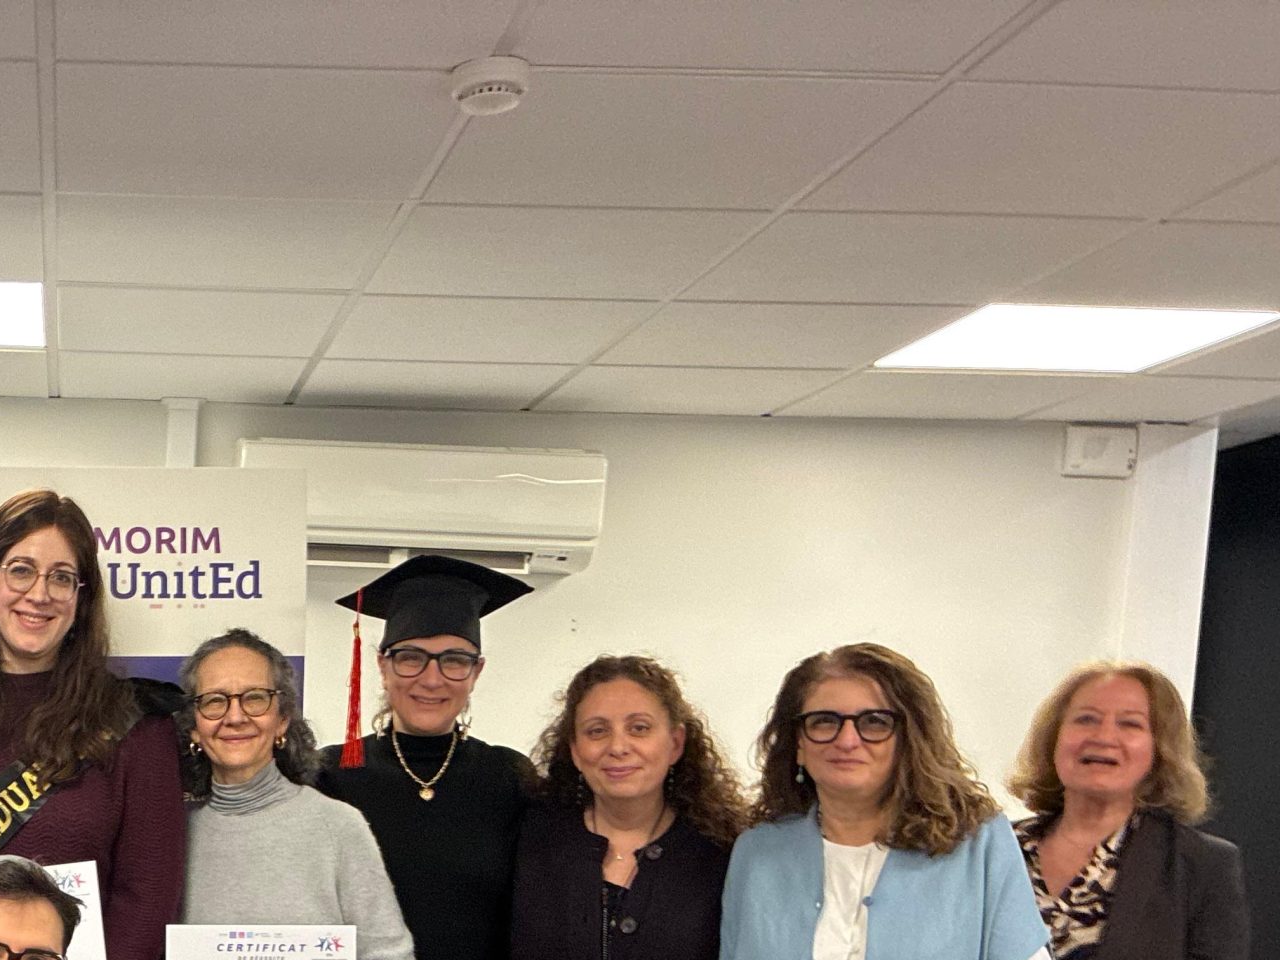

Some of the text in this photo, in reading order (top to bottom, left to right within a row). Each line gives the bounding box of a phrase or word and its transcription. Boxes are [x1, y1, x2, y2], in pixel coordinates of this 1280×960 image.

[94, 526, 221, 554] MORIM
[107, 560, 262, 599] UnitEd
[216, 943, 307, 952] CERTIFICAT
